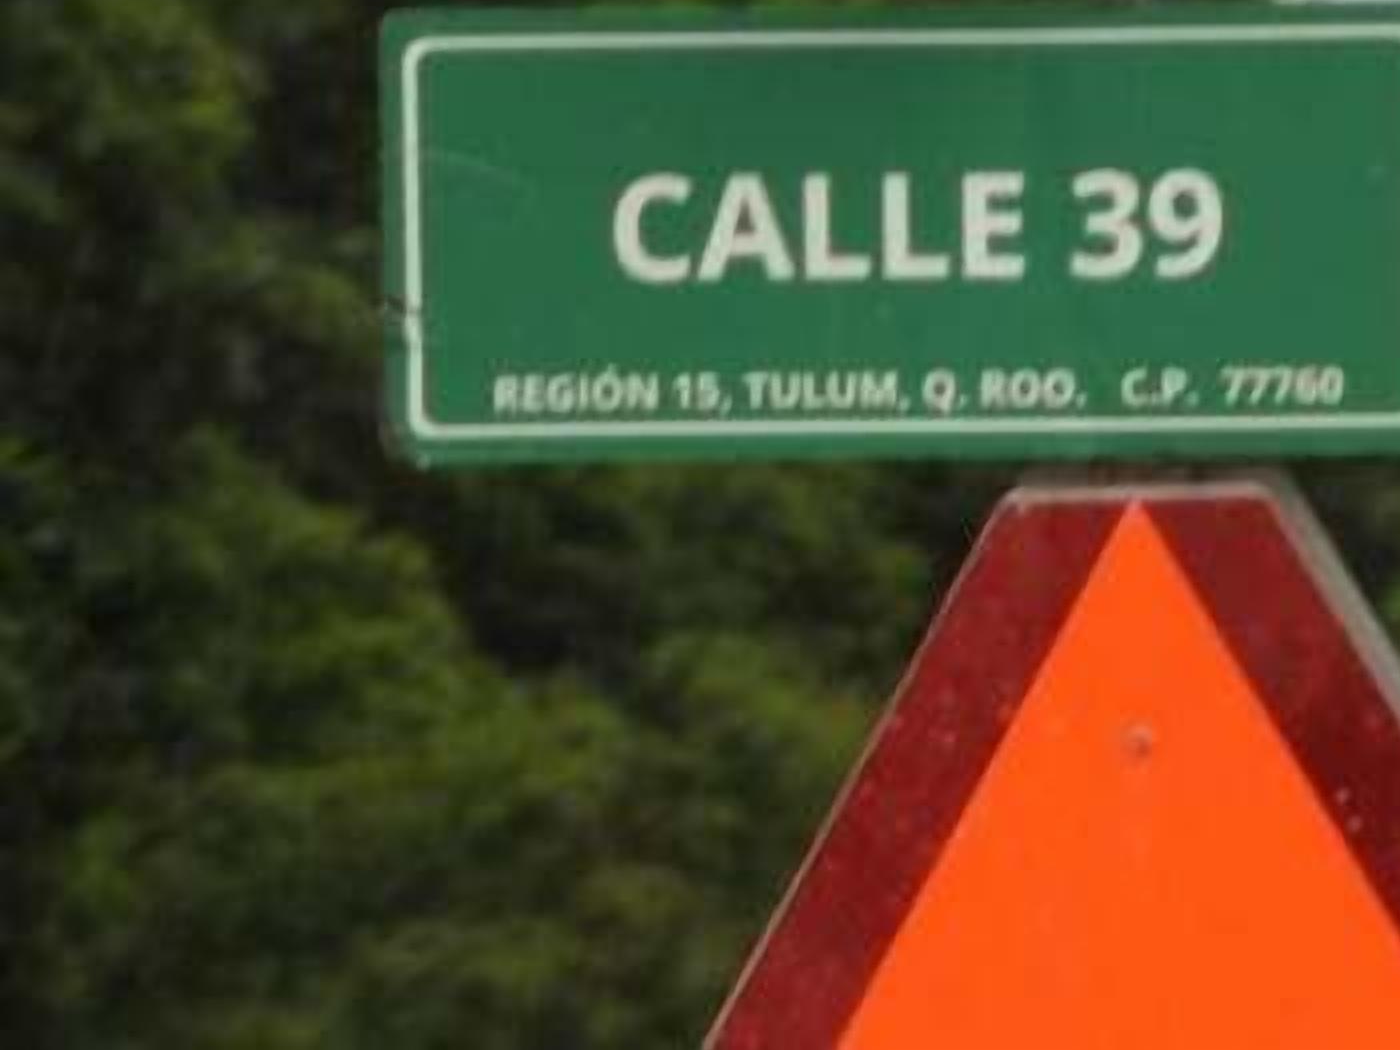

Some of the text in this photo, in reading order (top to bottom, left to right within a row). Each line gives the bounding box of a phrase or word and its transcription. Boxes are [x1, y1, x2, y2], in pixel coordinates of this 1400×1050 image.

[613, 168, 1224, 284] CALLE 39
[493, 363, 1345, 418] REGIÓN 15, TULUM, Q. ROO. C.P. 77760
